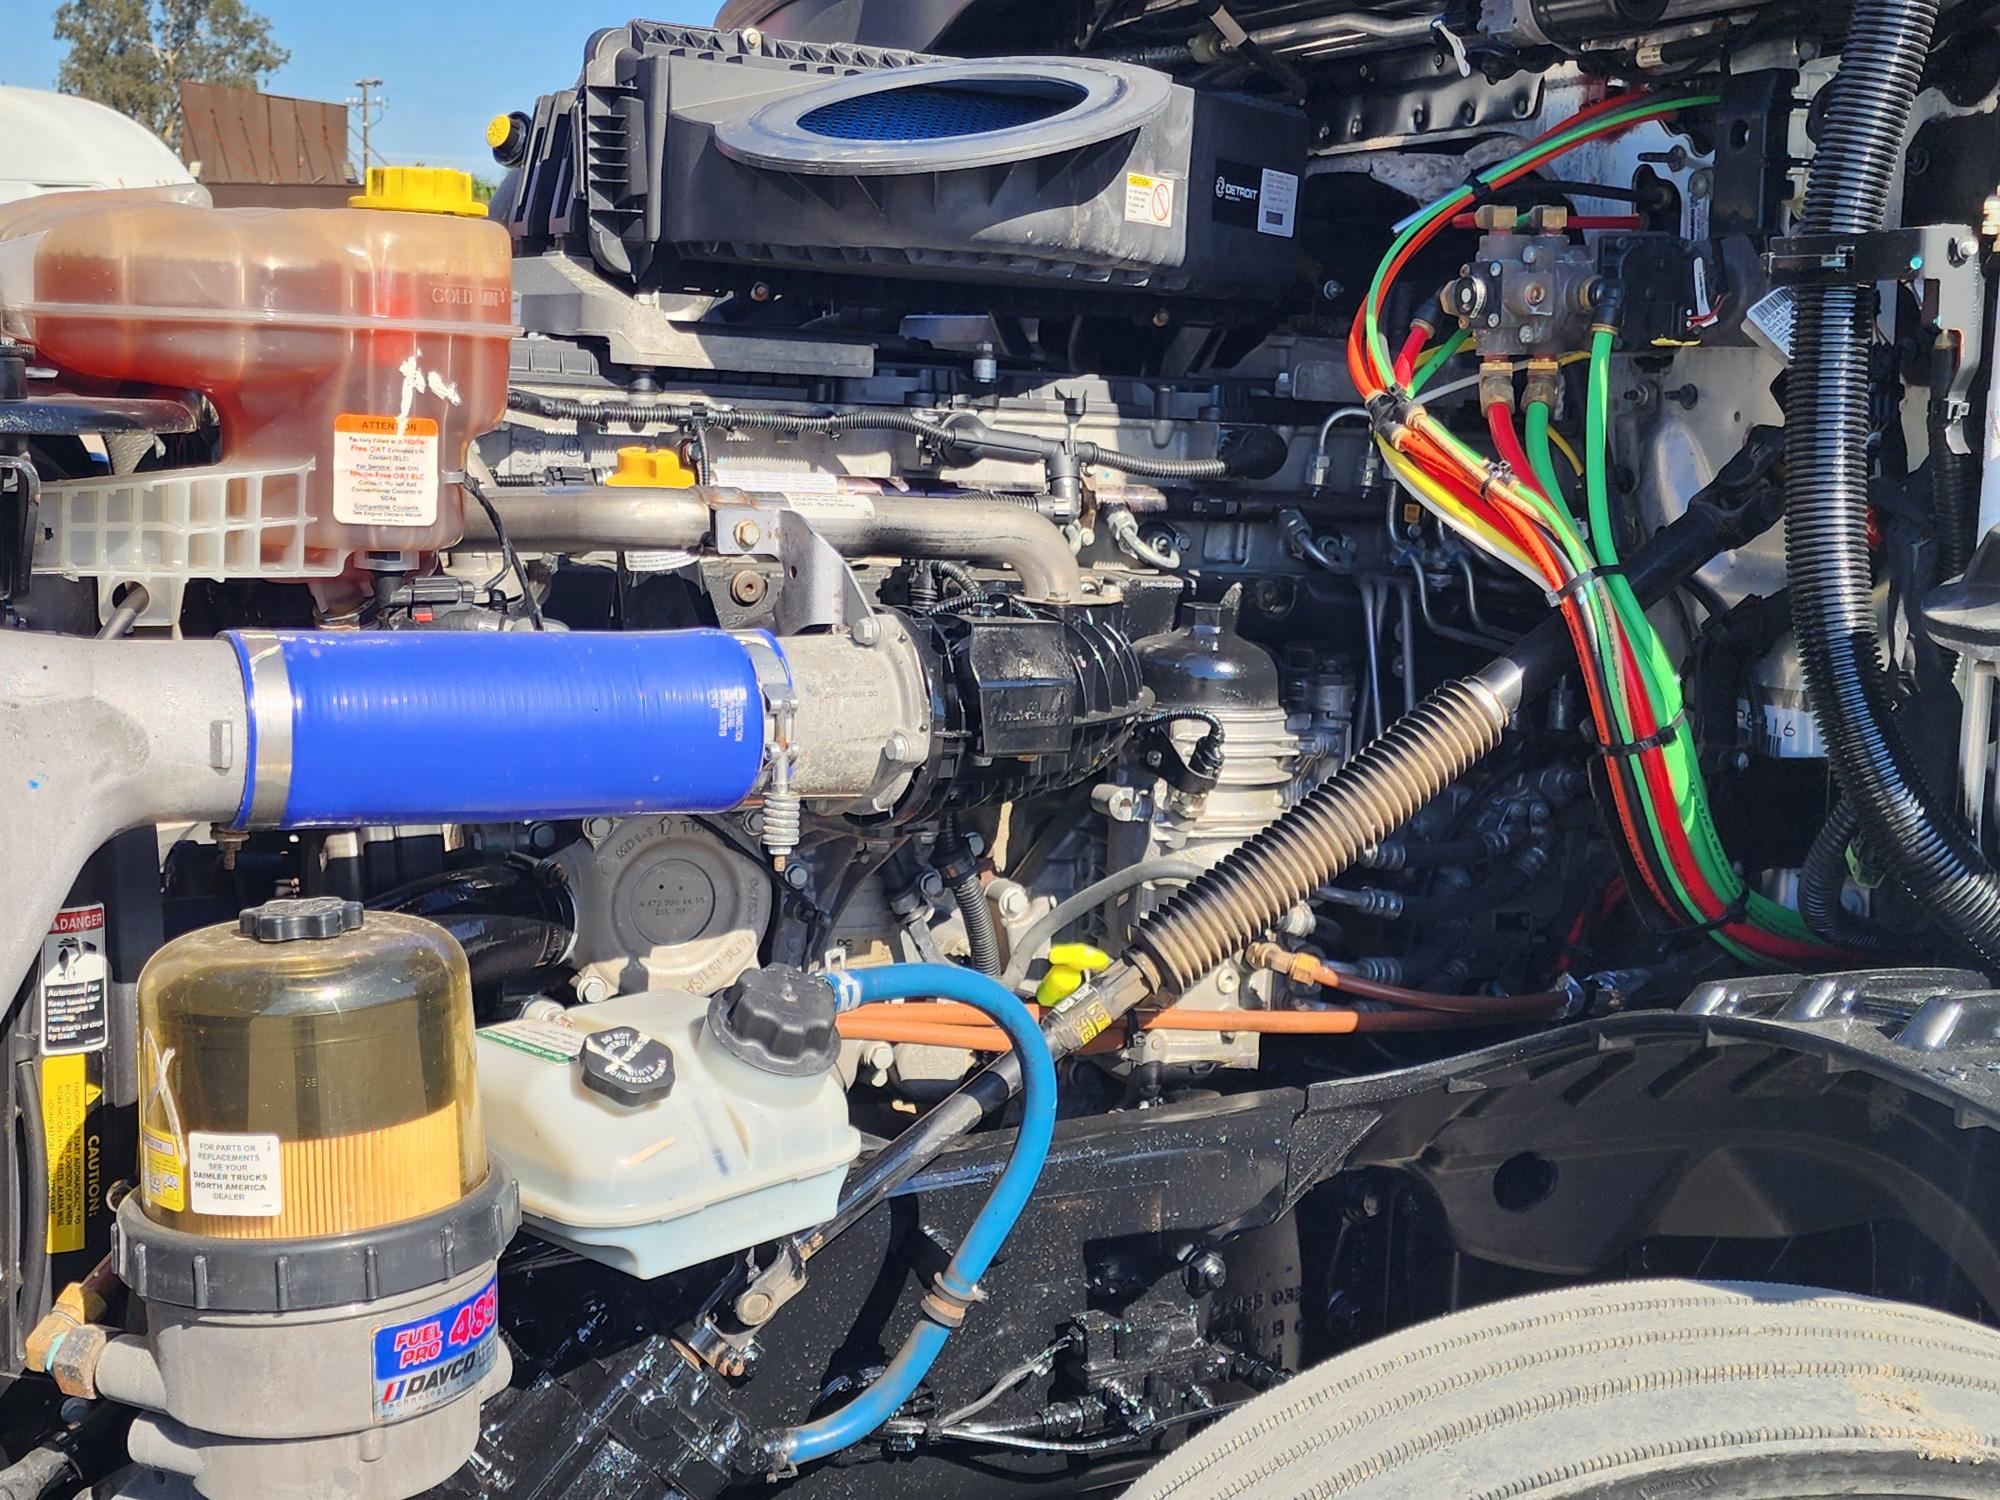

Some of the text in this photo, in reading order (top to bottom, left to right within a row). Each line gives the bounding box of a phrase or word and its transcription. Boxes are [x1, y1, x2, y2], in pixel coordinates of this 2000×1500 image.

[1225, 183, 1259, 200] DETROIT
[432, 288, 472, 304] COLD
[362, 421, 417, 431] ATTENON
[351, 444, 367, 452] Free
[60, 913, 103, 931] DANGER
[836, 938, 853, 947] DC
[47, 983, 99, 998] Automatic Fan
[47, 999, 66, 1008] Keep
[66, 997, 86, 1006] hands
[47, 1006, 66, 1015] when
[1086, 1000, 1106, 1023] NO
[48, 1025, 60, 1033] Fan
[1074, 1018, 1096, 1040] STE
[47, 1032, 57, 1042] by
[612, 1032, 631, 1042] NOT
[199, 1142, 256, 1153] FOR PARTS OR
[197, 1152, 260, 1162] REPLACEMENTS
[208, 1162, 248, 1172] SEE YOUR
[87, 1135, 100, 1217] CAUTION:
[193, 1171, 268, 1181] DAIMLER TRUCKS
[195, 1182, 266, 1191] NORTH AMERICA
[213, 1192, 245, 1201] DEALER
[394, 1320, 444, 1352] FUEL
[399, 1340, 443, 1369] PRO
[405, 1351, 476, 1398] DAVCO
